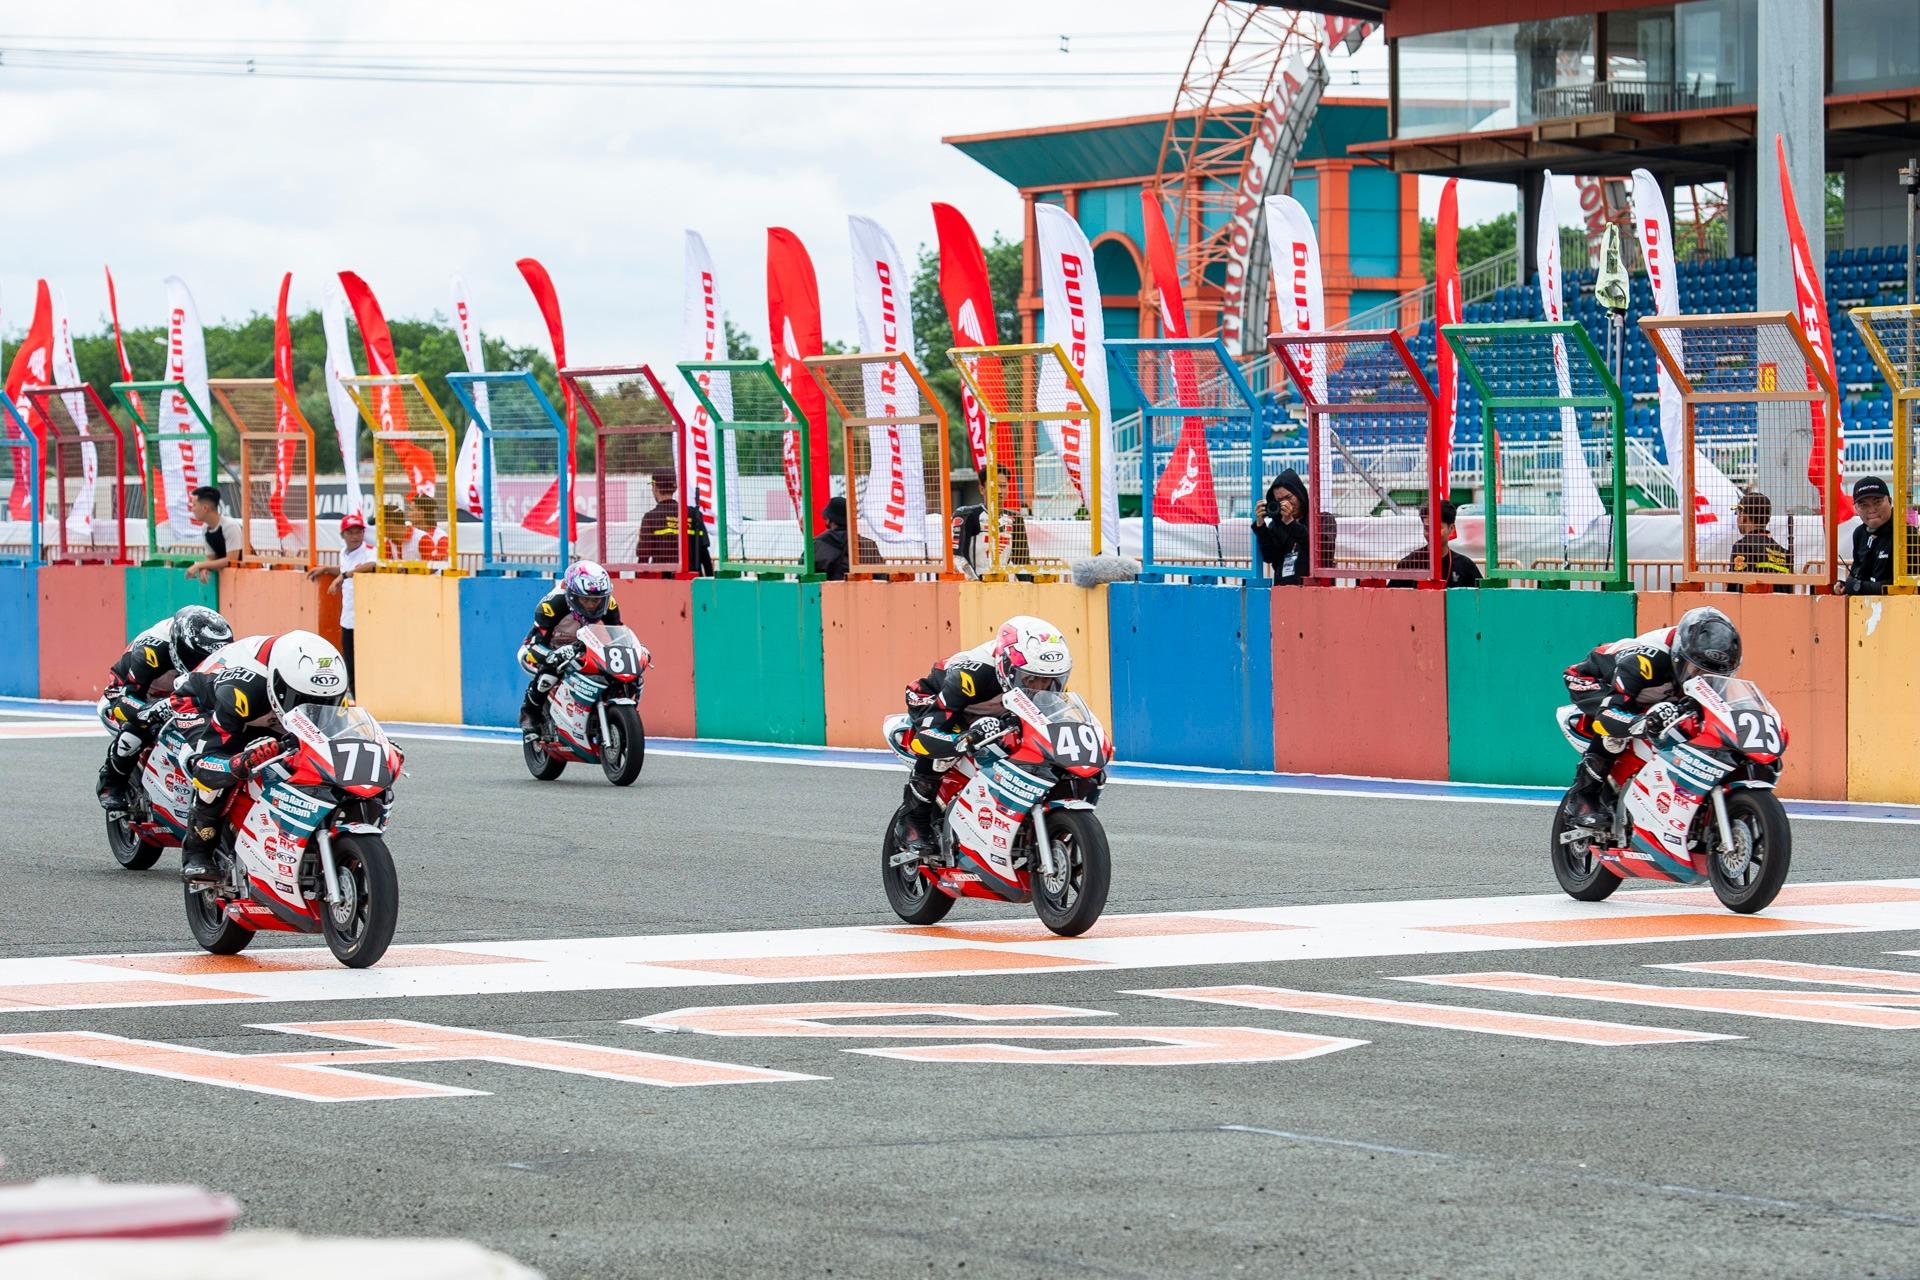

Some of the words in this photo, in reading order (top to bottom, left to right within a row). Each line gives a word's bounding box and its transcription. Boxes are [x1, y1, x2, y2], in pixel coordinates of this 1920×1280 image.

[691, 404, 715, 525] Honda
[883, 404, 905, 533] Honda
[609, 647, 638, 674] 81
[1042, 652, 1063, 662] KYT
[313, 675, 339, 686] KYT
[1056, 725, 1100, 764] 49
[1738, 712, 1781, 754] 25
[336, 743, 382, 783] 77
[1692, 757, 1725, 779] Racing
[1000, 777, 1035, 801] Vietnam
[1012, 775, 1045, 797] Racing
[269, 787, 289, 803] Honda
[289, 793, 320, 813] Racing
[1674, 795, 1690, 809] RK
[995, 817, 1011, 831] RK
[279, 837, 296, 852] RK
